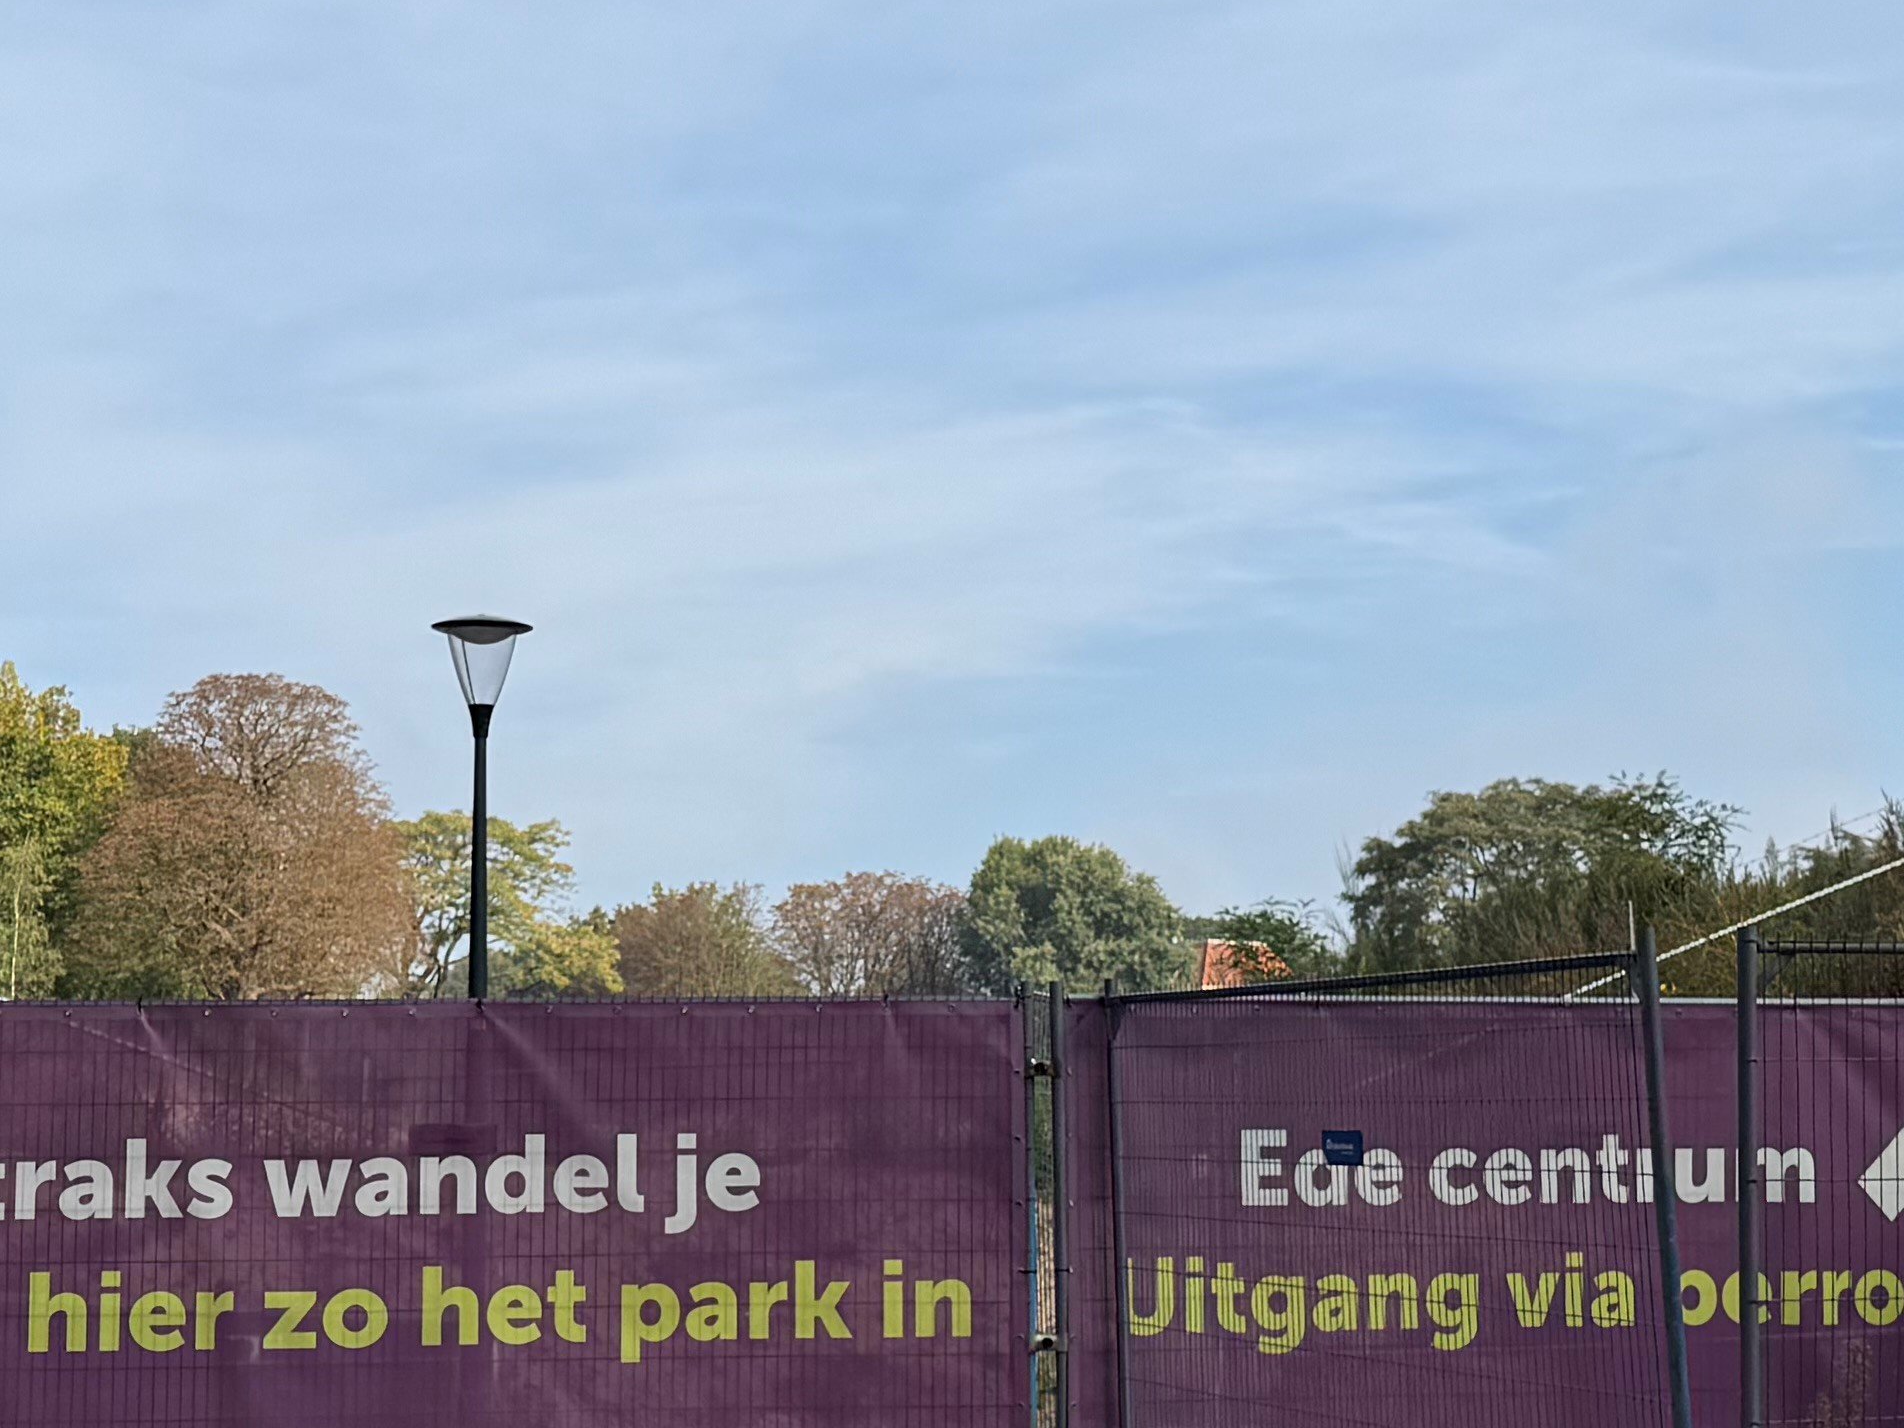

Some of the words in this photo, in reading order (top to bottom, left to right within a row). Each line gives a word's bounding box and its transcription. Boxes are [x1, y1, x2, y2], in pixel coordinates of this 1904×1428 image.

[263, 1134, 645, 1219] wandel
[664, 1133, 762, 1236] je
[1240, 1129, 1404, 1208] Ede
[27, 1270, 236, 1354] hier
[263, 1289, 389, 1351] zo
[421, 1266, 587, 1347] het
[620, 1260, 854, 1365] park
[884, 1259, 973, 1339] in
[1127, 1256, 1479, 1356] Uitgang
[1506, 1251, 1635, 1329] via
